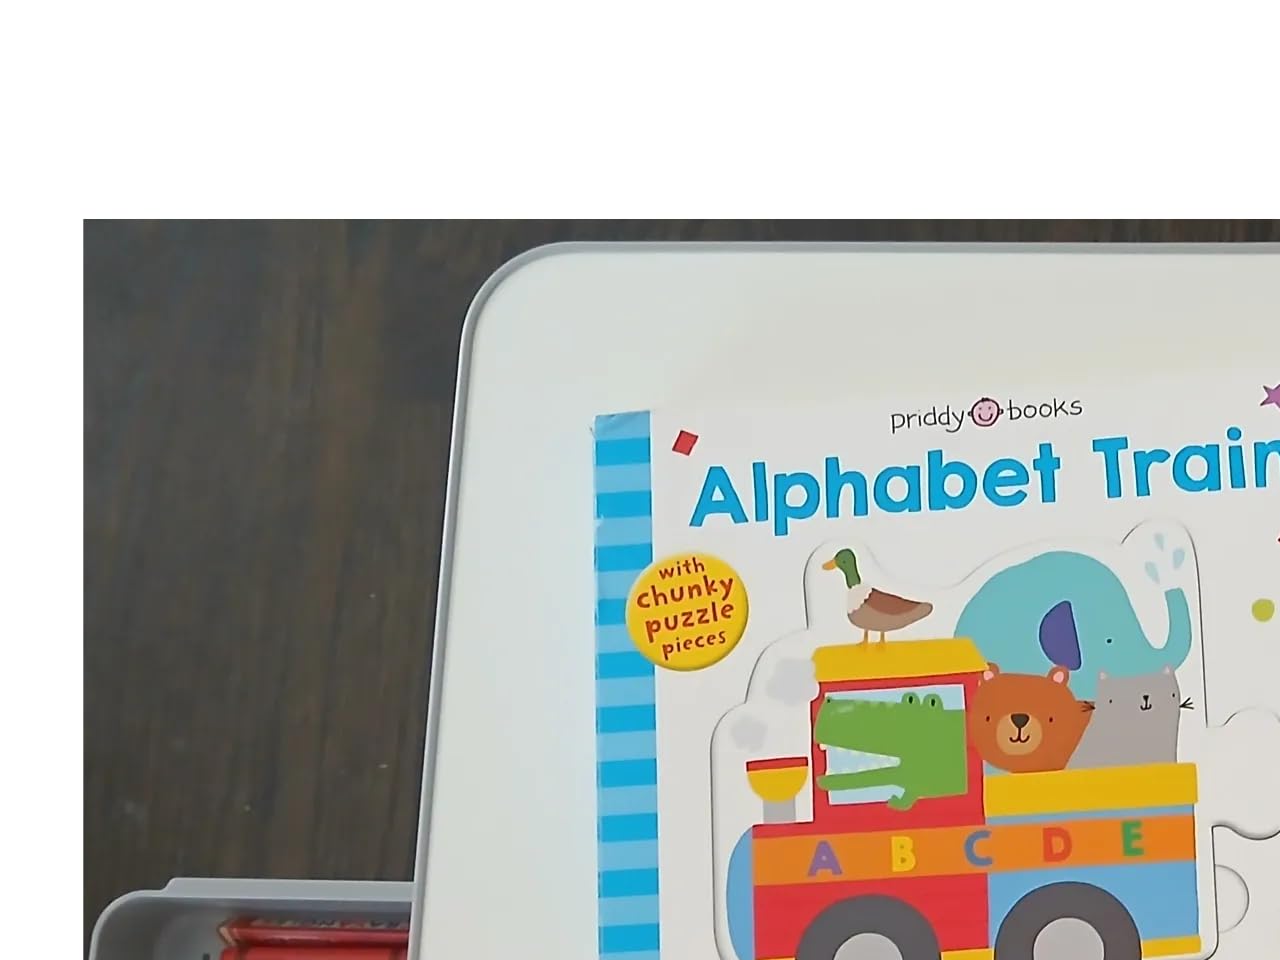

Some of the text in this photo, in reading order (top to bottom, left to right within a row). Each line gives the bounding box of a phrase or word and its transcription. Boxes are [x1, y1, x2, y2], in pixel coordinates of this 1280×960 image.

[891, 397, 1083, 433] priddy books
[689, 441, 1062, 537] Alphabet
[659, 556, 705, 580] with
[636, 574, 734, 608] chunky
[645, 601, 735, 643] puzzle
[662, 630, 726, 661] pieces
[807, 820, 1145, 876] A B C D E
